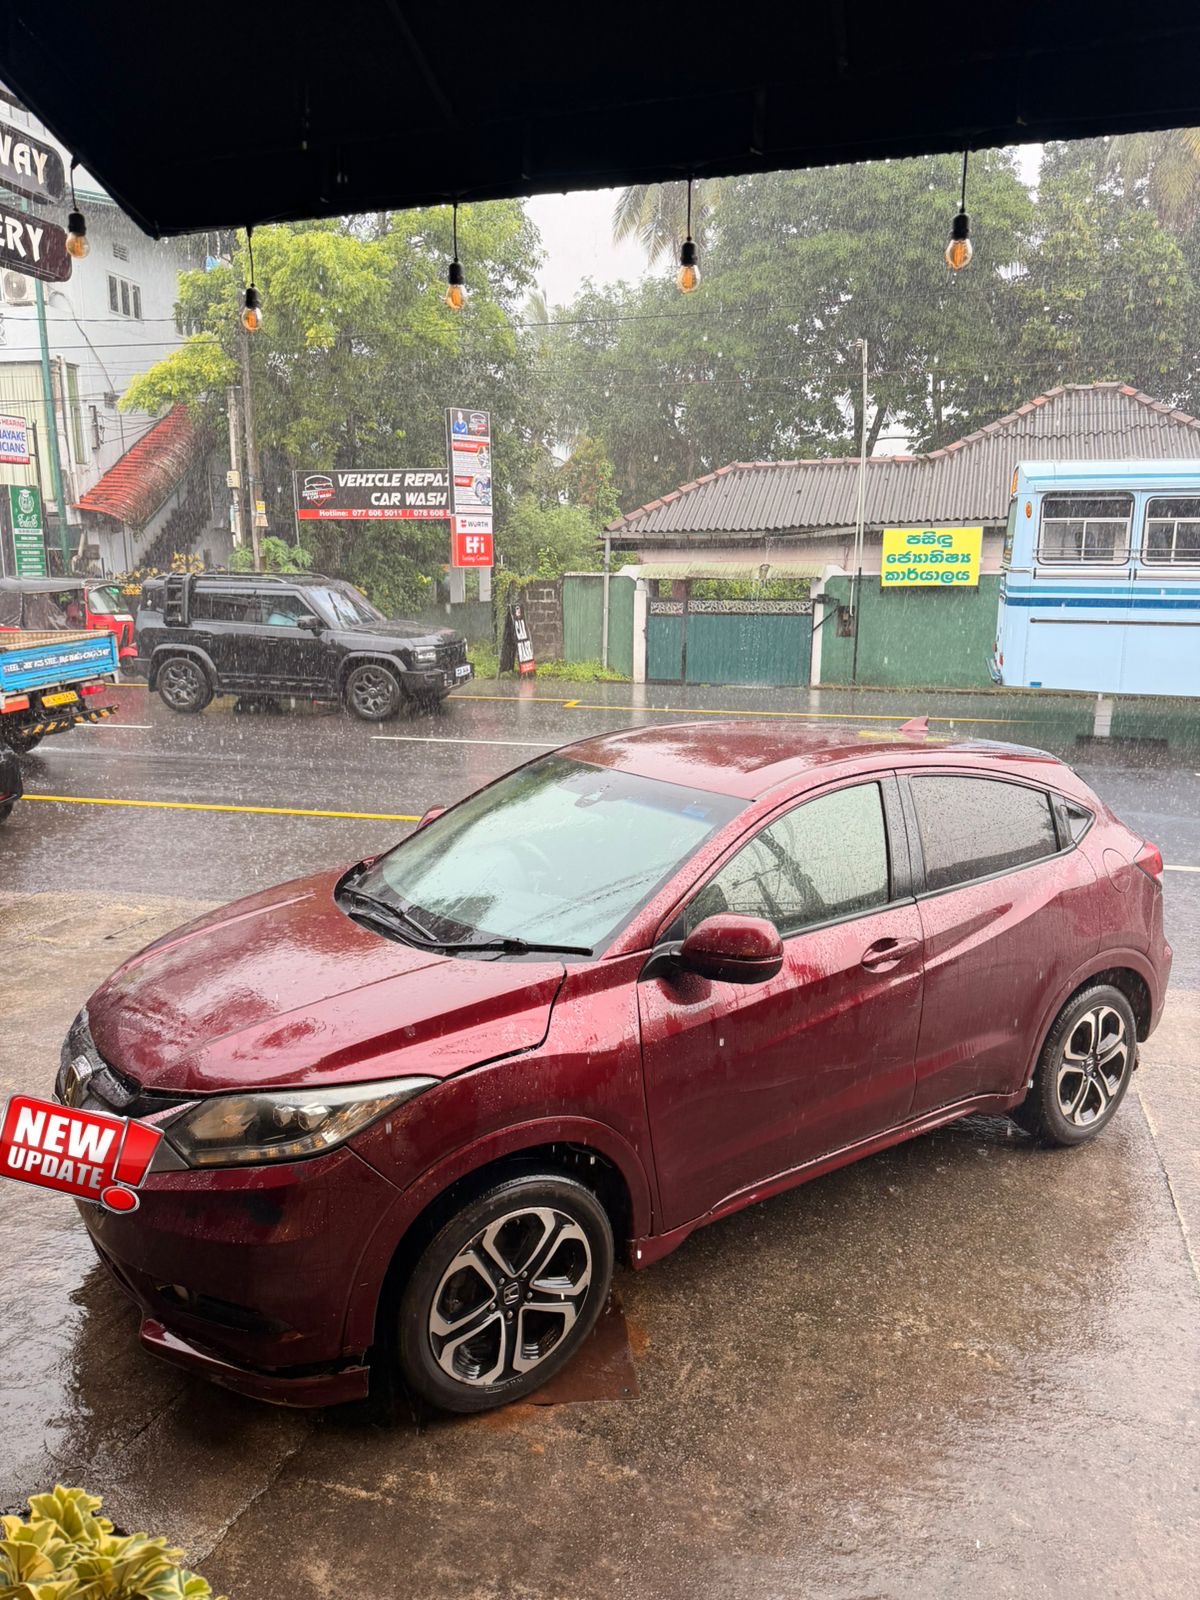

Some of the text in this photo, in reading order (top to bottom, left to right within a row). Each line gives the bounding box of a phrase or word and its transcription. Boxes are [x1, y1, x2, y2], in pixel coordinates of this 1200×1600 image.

[338, 473, 402, 487] VEHICLE
[371, 492, 401, 506] CAR
[405, 492, 447, 506] WASH
[319, 509, 349, 517] Hotline:
[352, 509, 366, 517] 077
